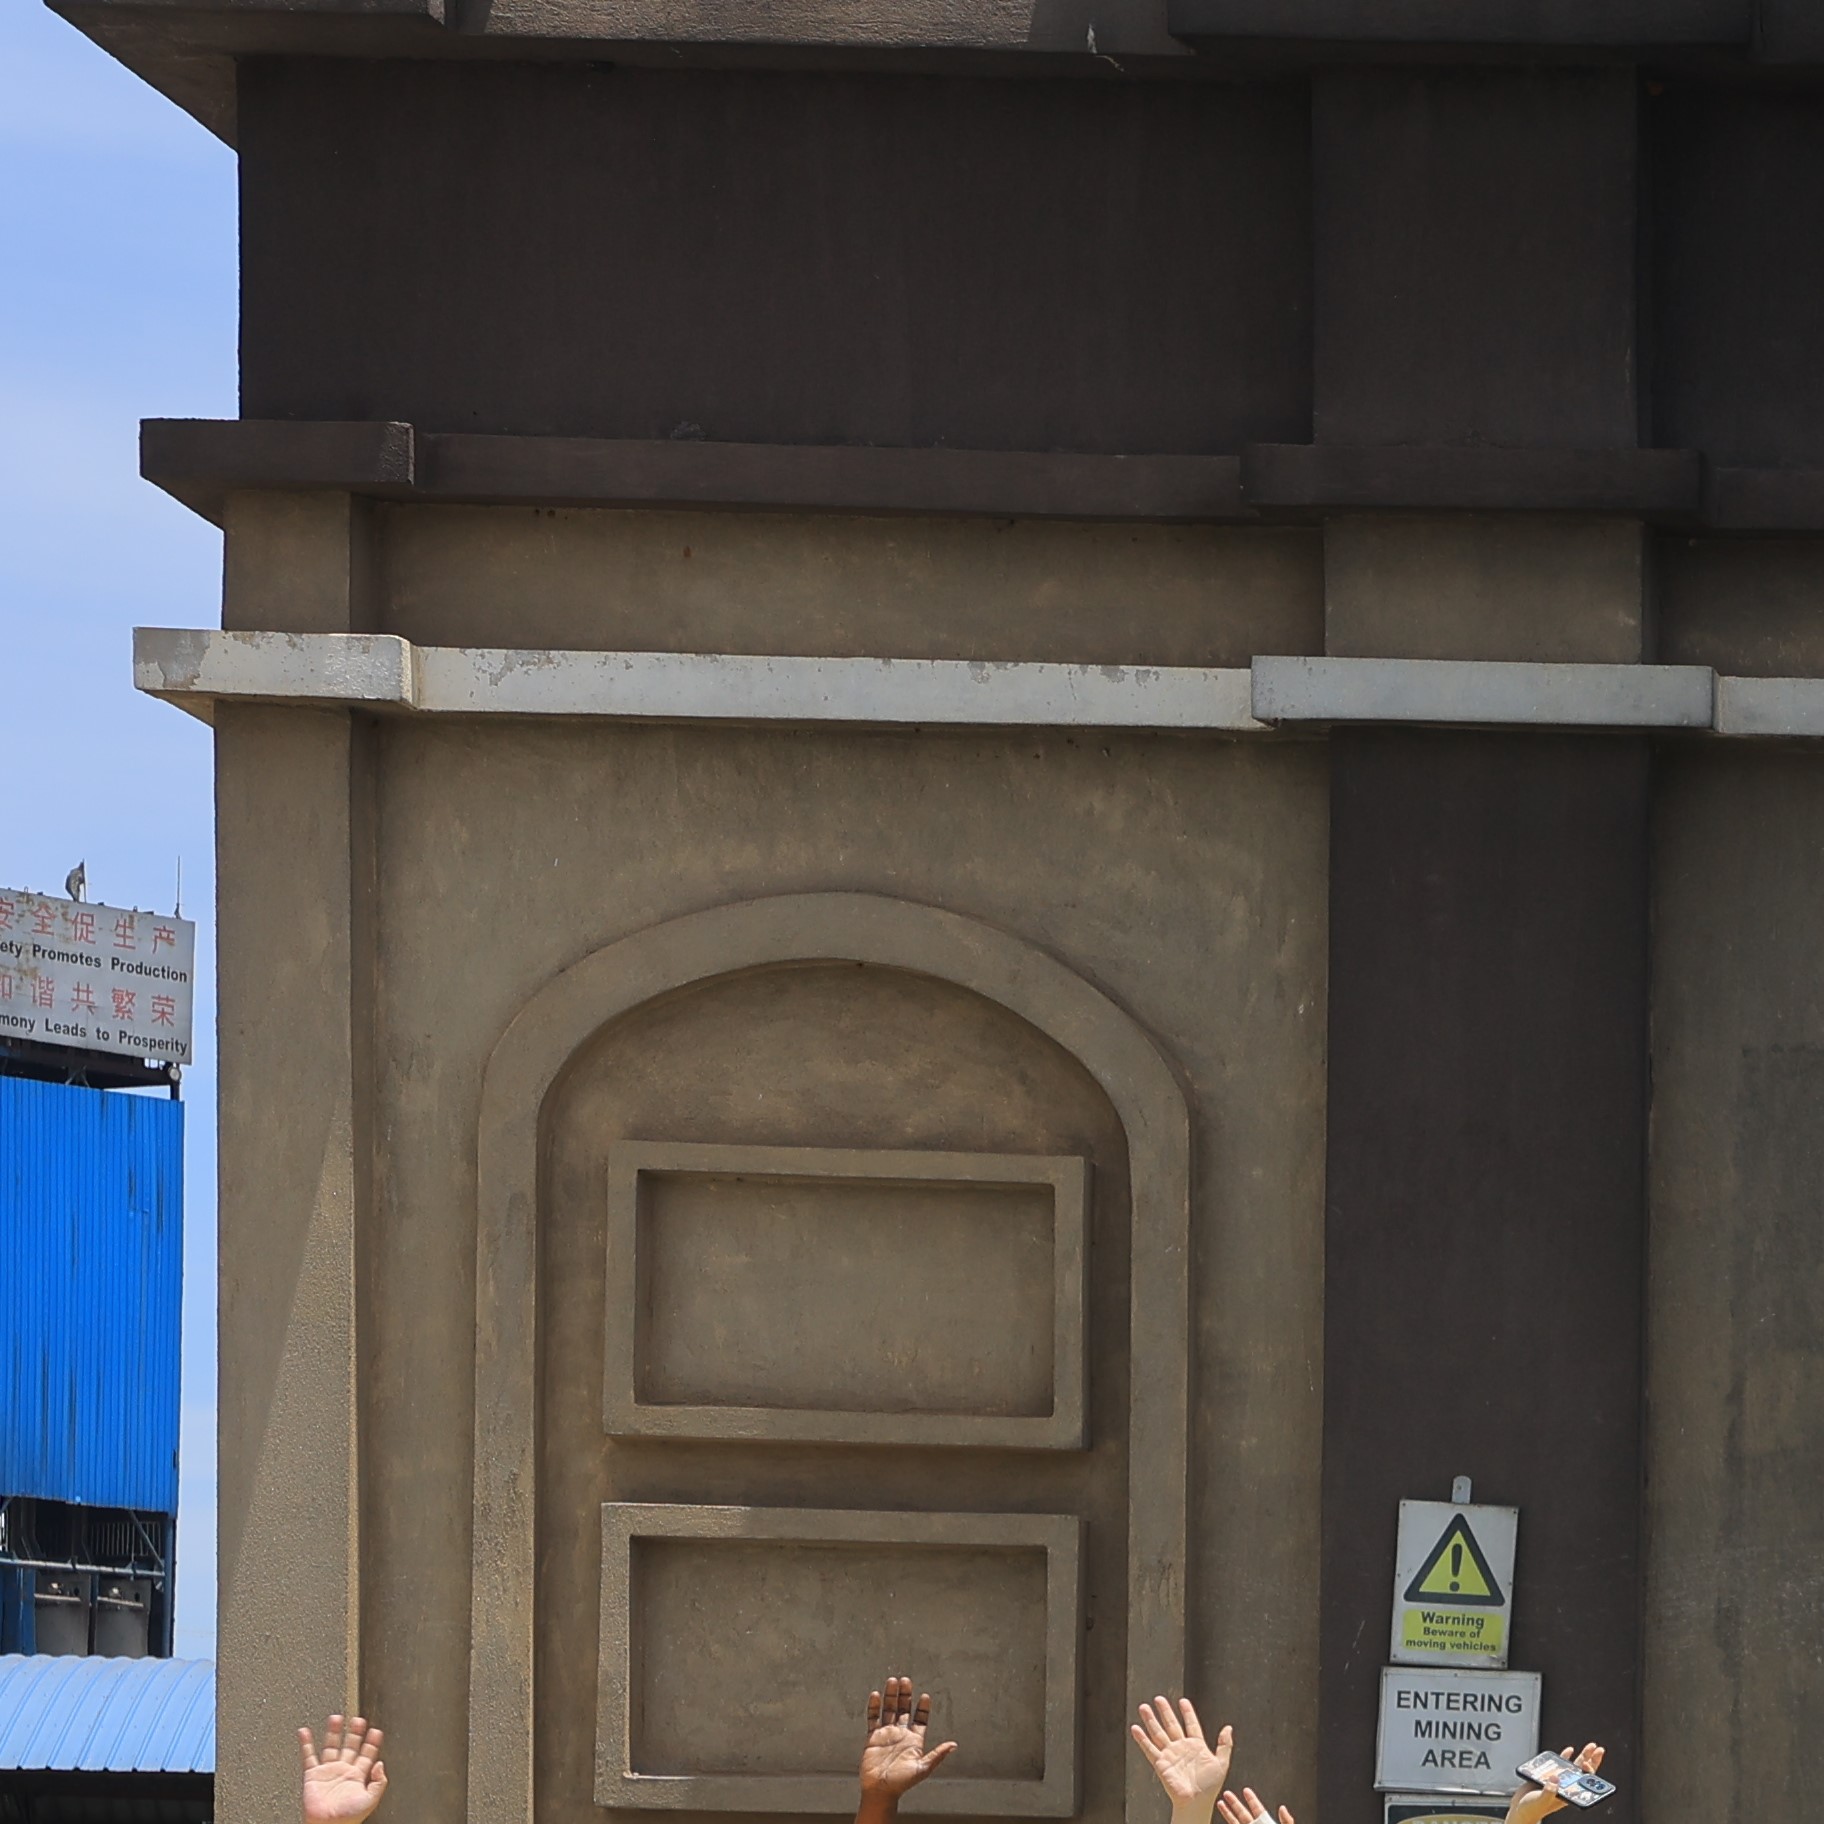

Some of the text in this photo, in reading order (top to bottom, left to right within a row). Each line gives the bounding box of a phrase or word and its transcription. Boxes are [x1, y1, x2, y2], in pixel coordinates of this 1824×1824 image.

[0, 941, 188, 983] ety Promotes Production
[0, 1013, 188, 1056] mony Leads to Prosperity
[1421, 1611, 1485, 1630] Warning
[1423, 1626, 1482, 1638] Beware of
[1406, 1639, 1497, 1652] moving vehicles
[1396, 1690, 1523, 1714] ENTERING
[1414, 1719, 1502, 1742] MINING
[1421, 1748, 1492, 1770] AREA
